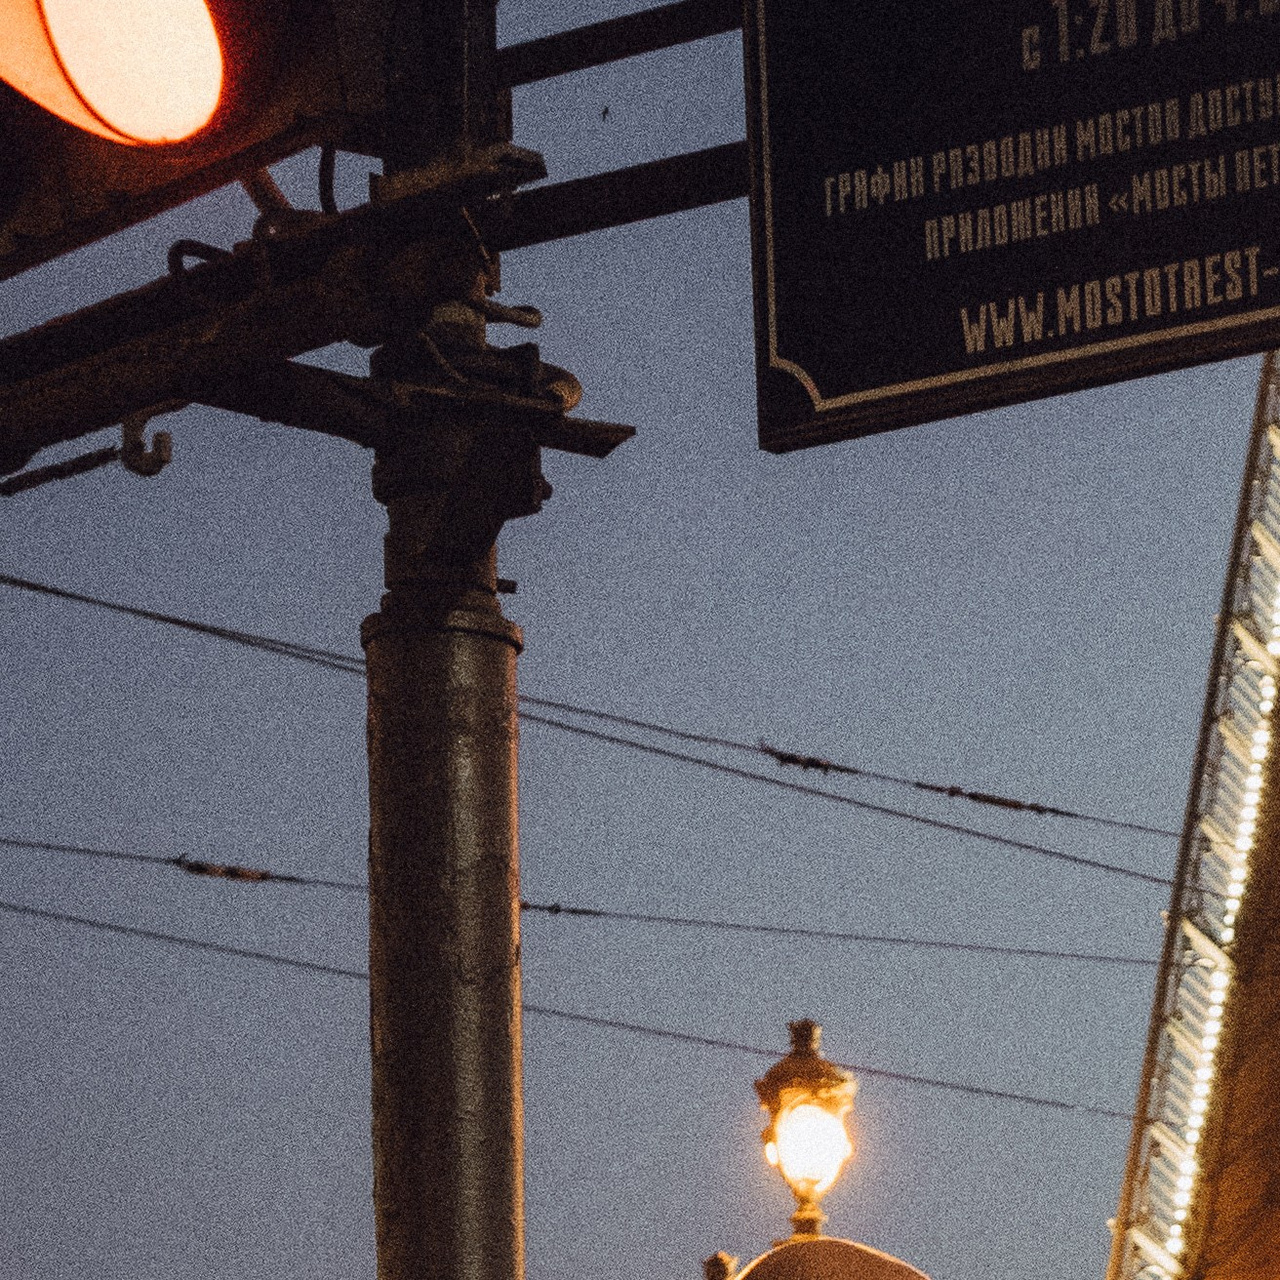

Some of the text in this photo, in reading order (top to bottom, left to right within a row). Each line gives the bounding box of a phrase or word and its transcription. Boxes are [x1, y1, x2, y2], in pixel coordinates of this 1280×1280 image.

[824, 156, 925, 217] ГРАФИК
[932, 123, 1068, 194] РАЗВОДКИ
[1075, 97, 1180, 162] МОСТОВ
[924, 183, 1100, 261] ПРИЛОЖЕНИИ
[1108, 154, 1227, 215] «МОСТЫ
